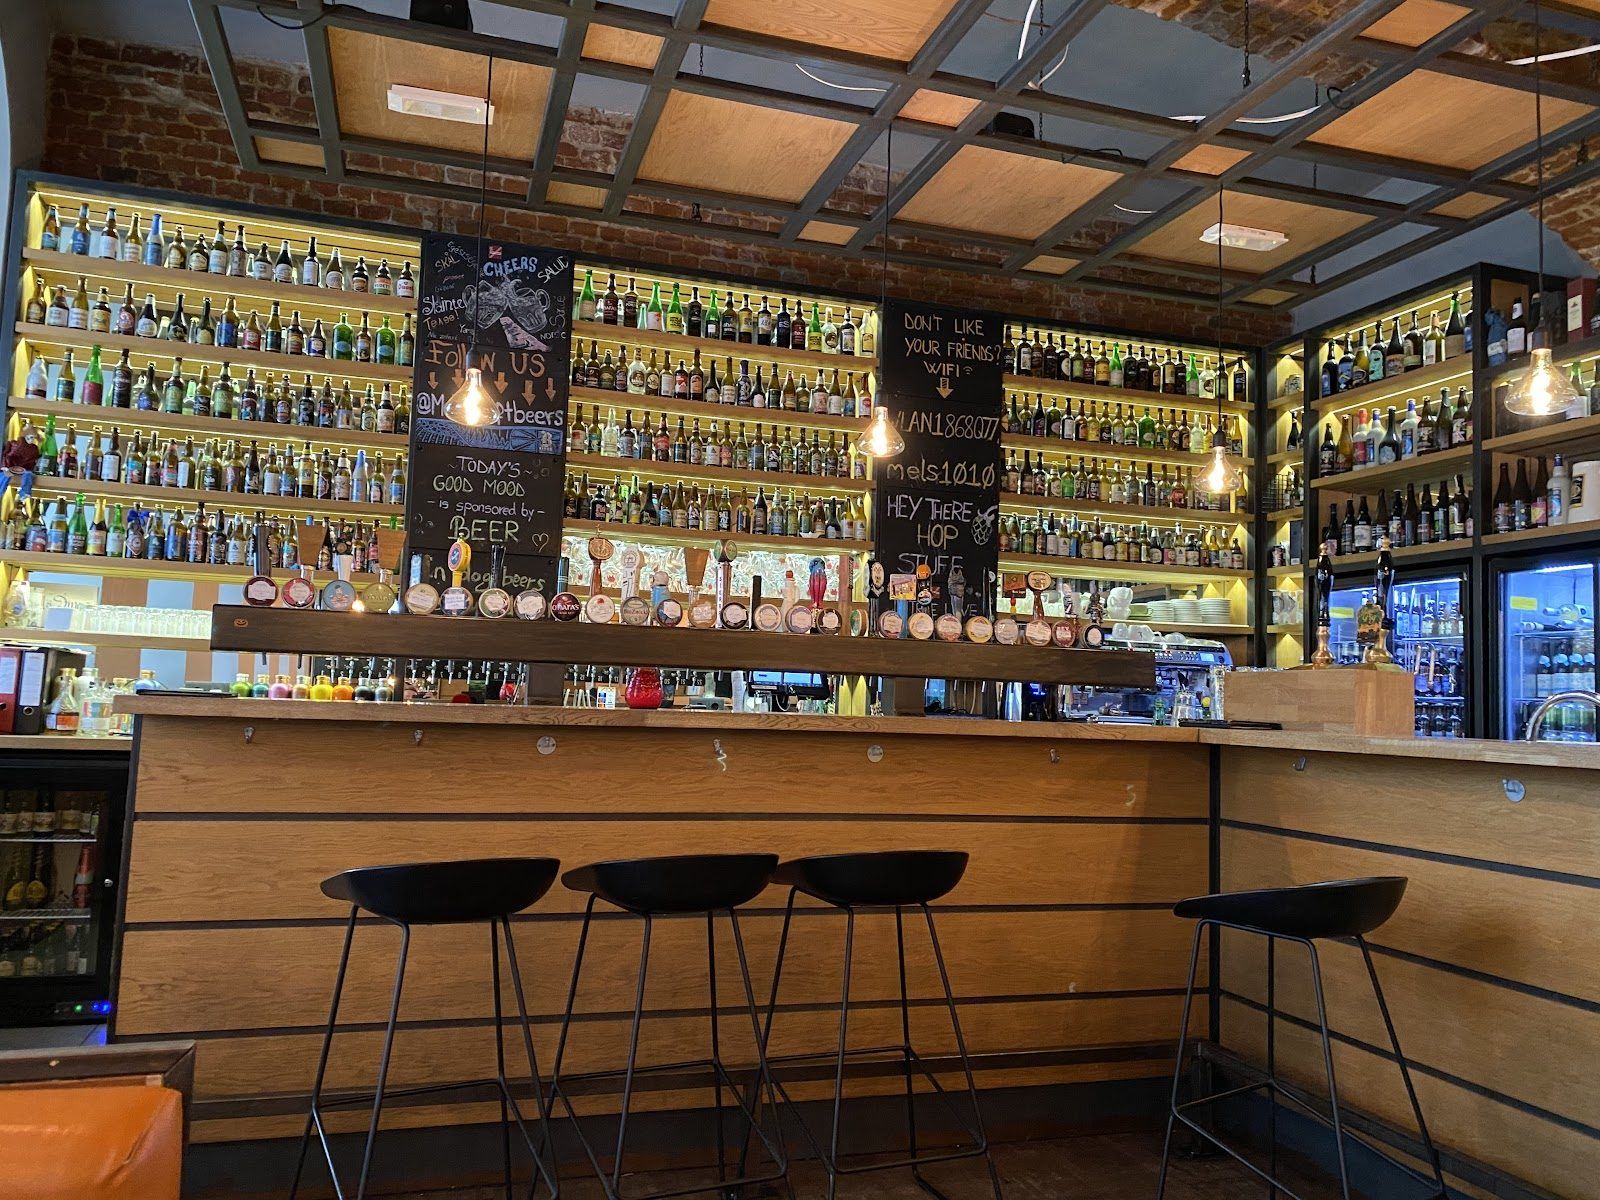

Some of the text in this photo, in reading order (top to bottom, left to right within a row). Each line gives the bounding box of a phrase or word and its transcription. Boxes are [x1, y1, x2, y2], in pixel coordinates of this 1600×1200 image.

[483, 256, 538, 277] CHEERS
[904, 312, 985, 336] DON'T LIKE
[904, 337, 941, 357] YOUR
[923, 360, 960, 378] WIFI
[455, 455, 521, 478] TODAY'S
[433, 474, 526, 497] GOOD MOOD
[439, 500, 535, 522] is sponsored by
[887, 494, 923, 520] HEY
[448, 515, 520, 543] BEER
[917, 524, 959, 550] HOP
[502, 566, 546, 593] beers
